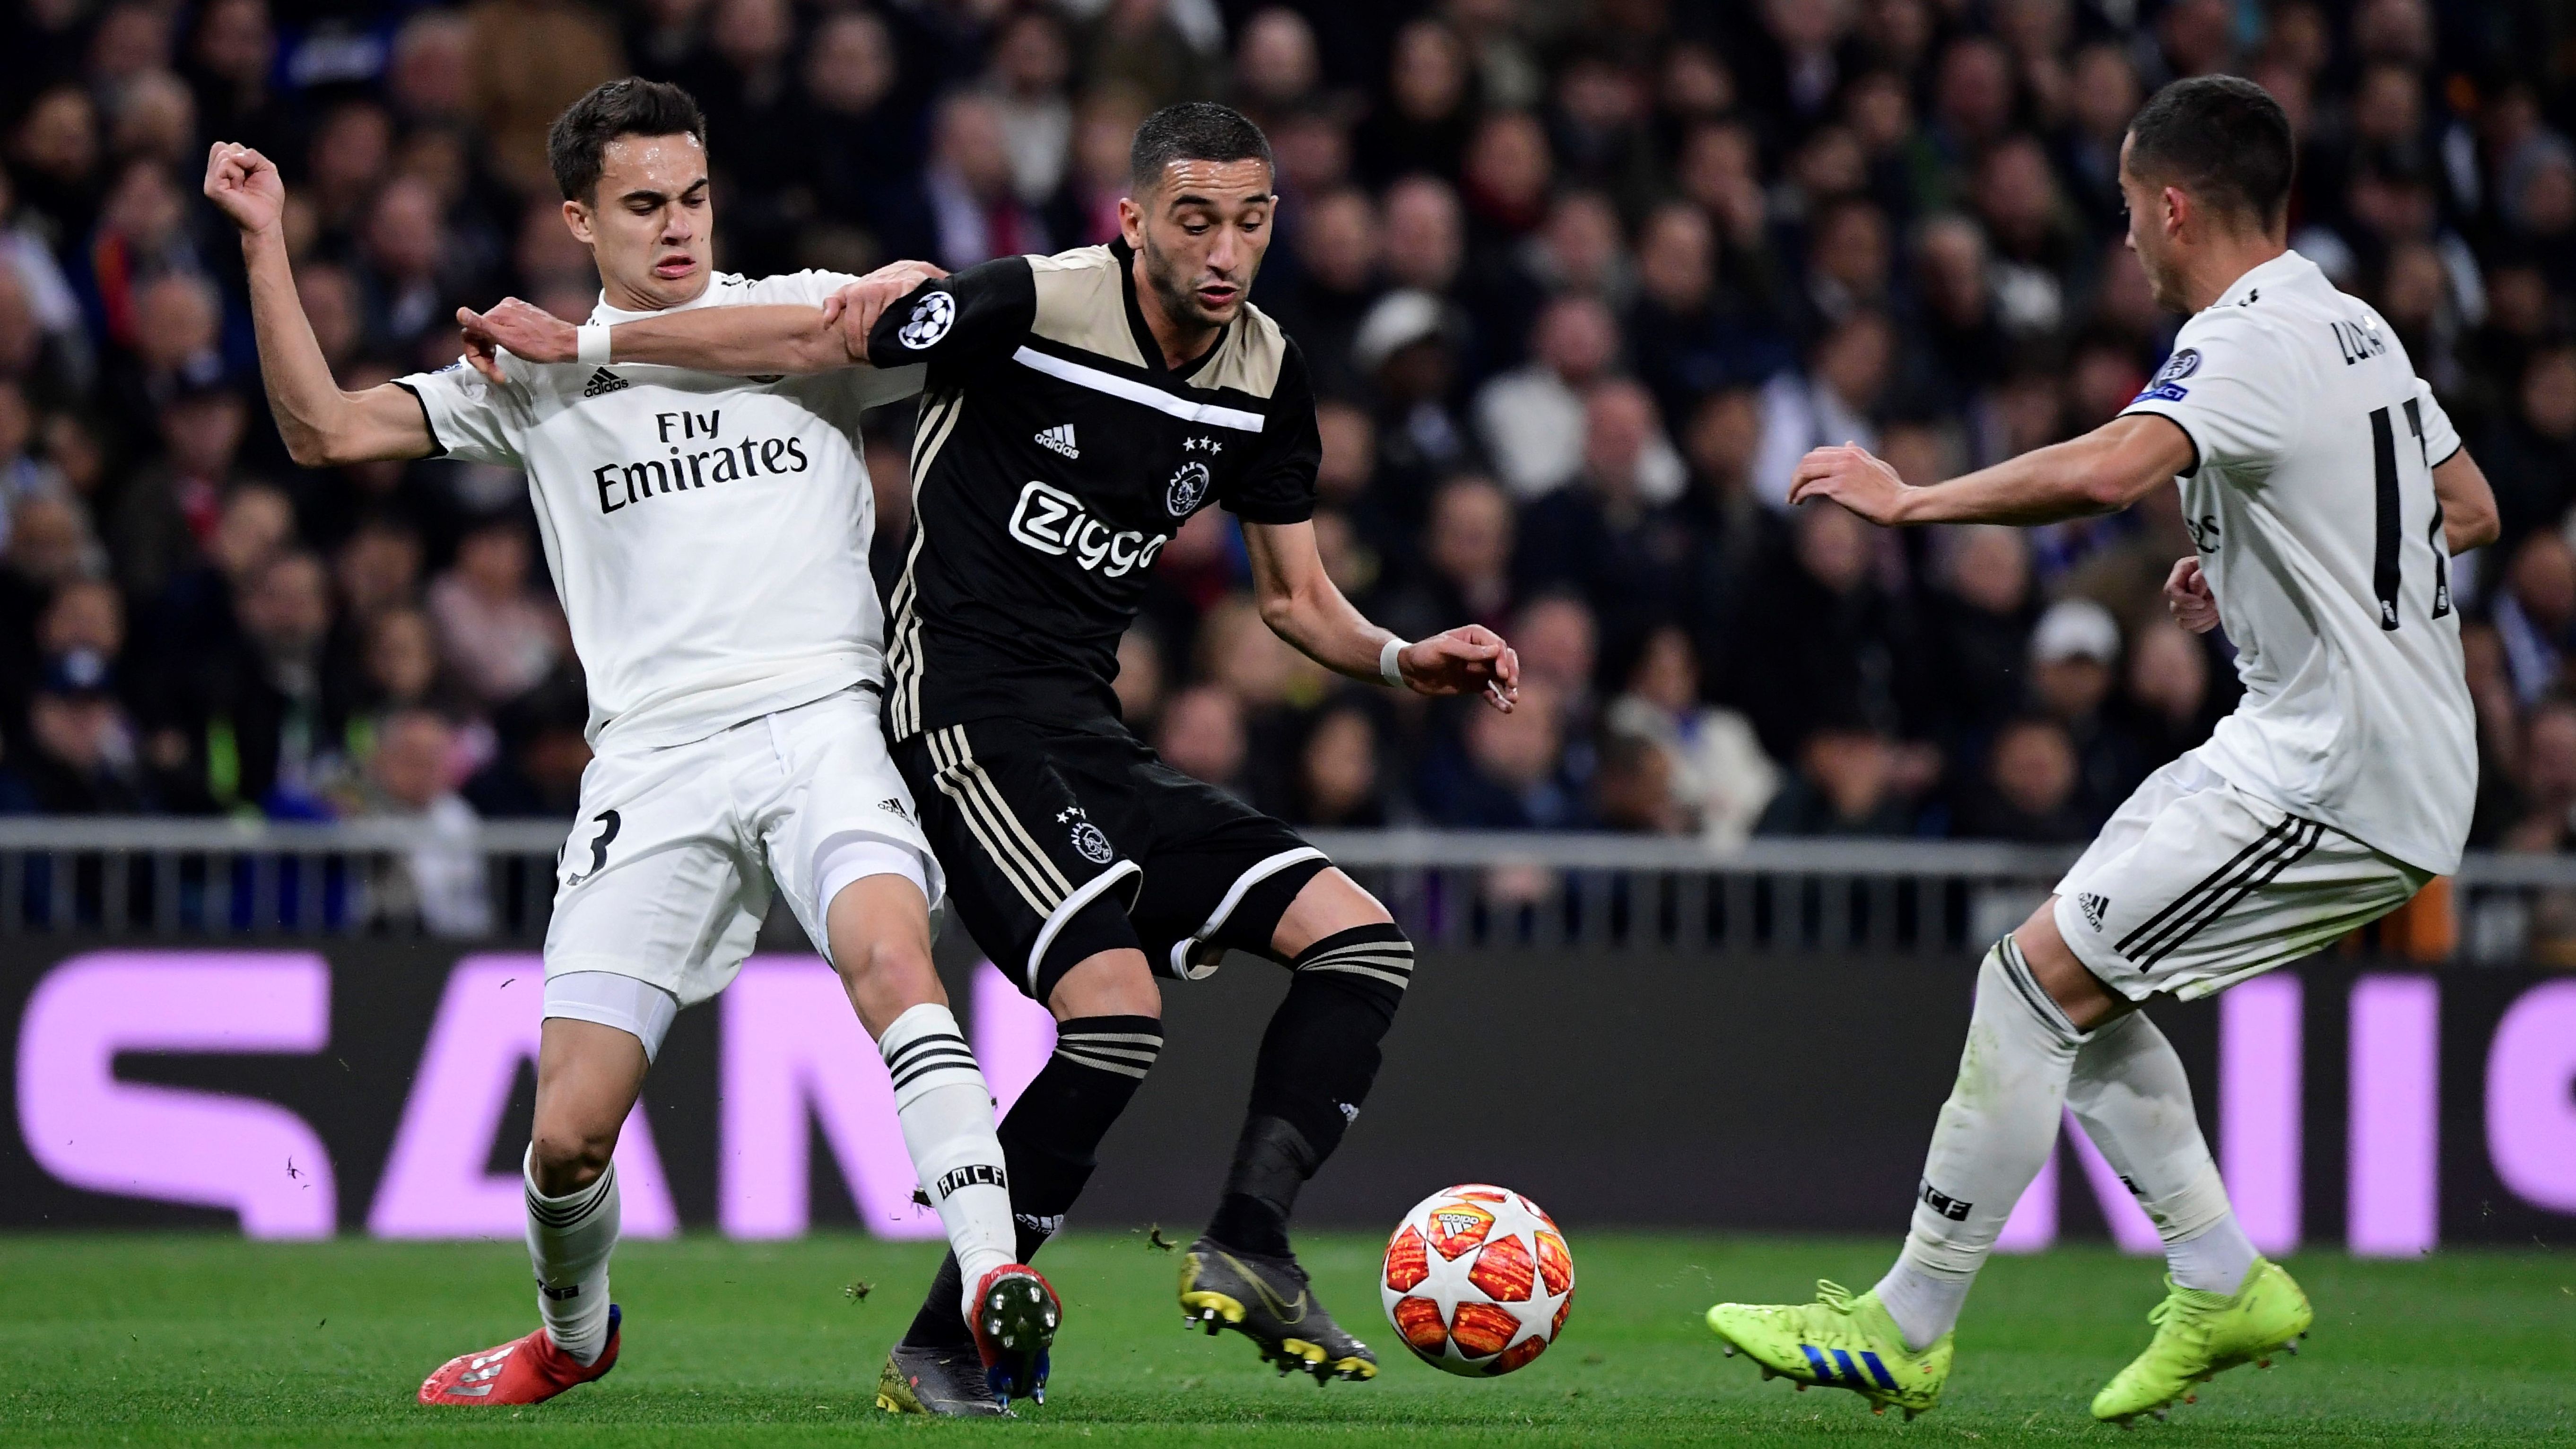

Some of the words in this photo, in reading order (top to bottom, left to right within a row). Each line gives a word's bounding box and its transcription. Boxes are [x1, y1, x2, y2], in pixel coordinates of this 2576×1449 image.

[584, 380, 629, 398] adidas
[656, 409, 720, 443] Fly
[1035, 434, 1079, 460] adidas
[593, 435, 808, 514] Emirates
[1026, 495, 1167, 577] Ziggo
[561, 809, 621, 886] 3
[2078, 893, 2102, 932] adidas
[1438, 1214, 1479, 1225] adidas
